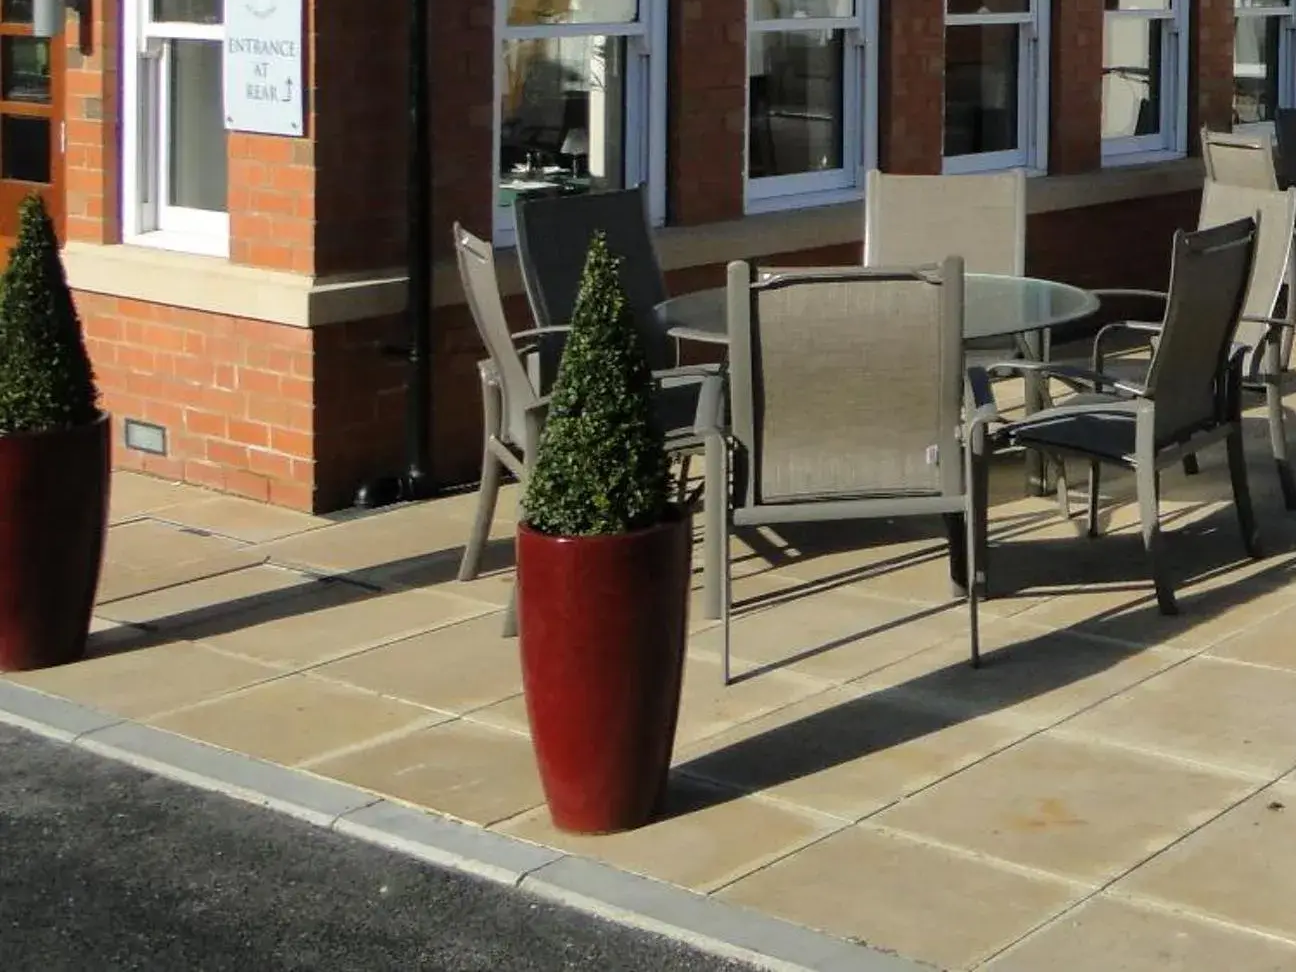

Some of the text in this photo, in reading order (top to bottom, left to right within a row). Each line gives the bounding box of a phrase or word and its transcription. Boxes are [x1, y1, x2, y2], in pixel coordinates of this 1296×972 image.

[228, 37, 296, 58] ENTRANCE
[253, 62, 271, 79] AT
[246, 83, 279, 103] REAR
